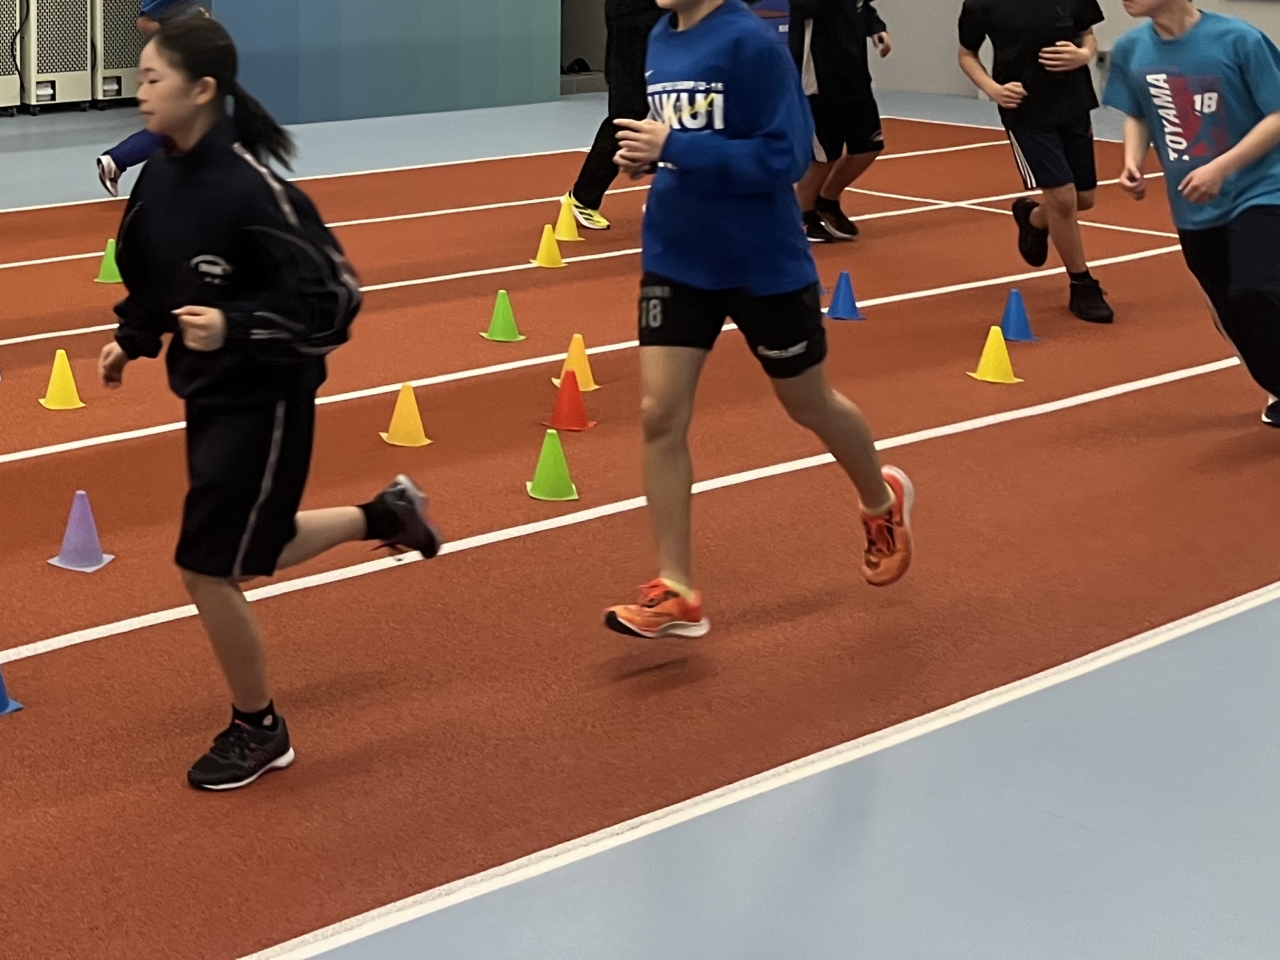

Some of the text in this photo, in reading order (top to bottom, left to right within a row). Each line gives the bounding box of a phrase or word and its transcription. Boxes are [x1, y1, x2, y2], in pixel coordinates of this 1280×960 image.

[1146, 73, 1190, 163] TOYAMA
[1193, 91, 1219, 116] 18
[641, 299, 663, 328] 18
